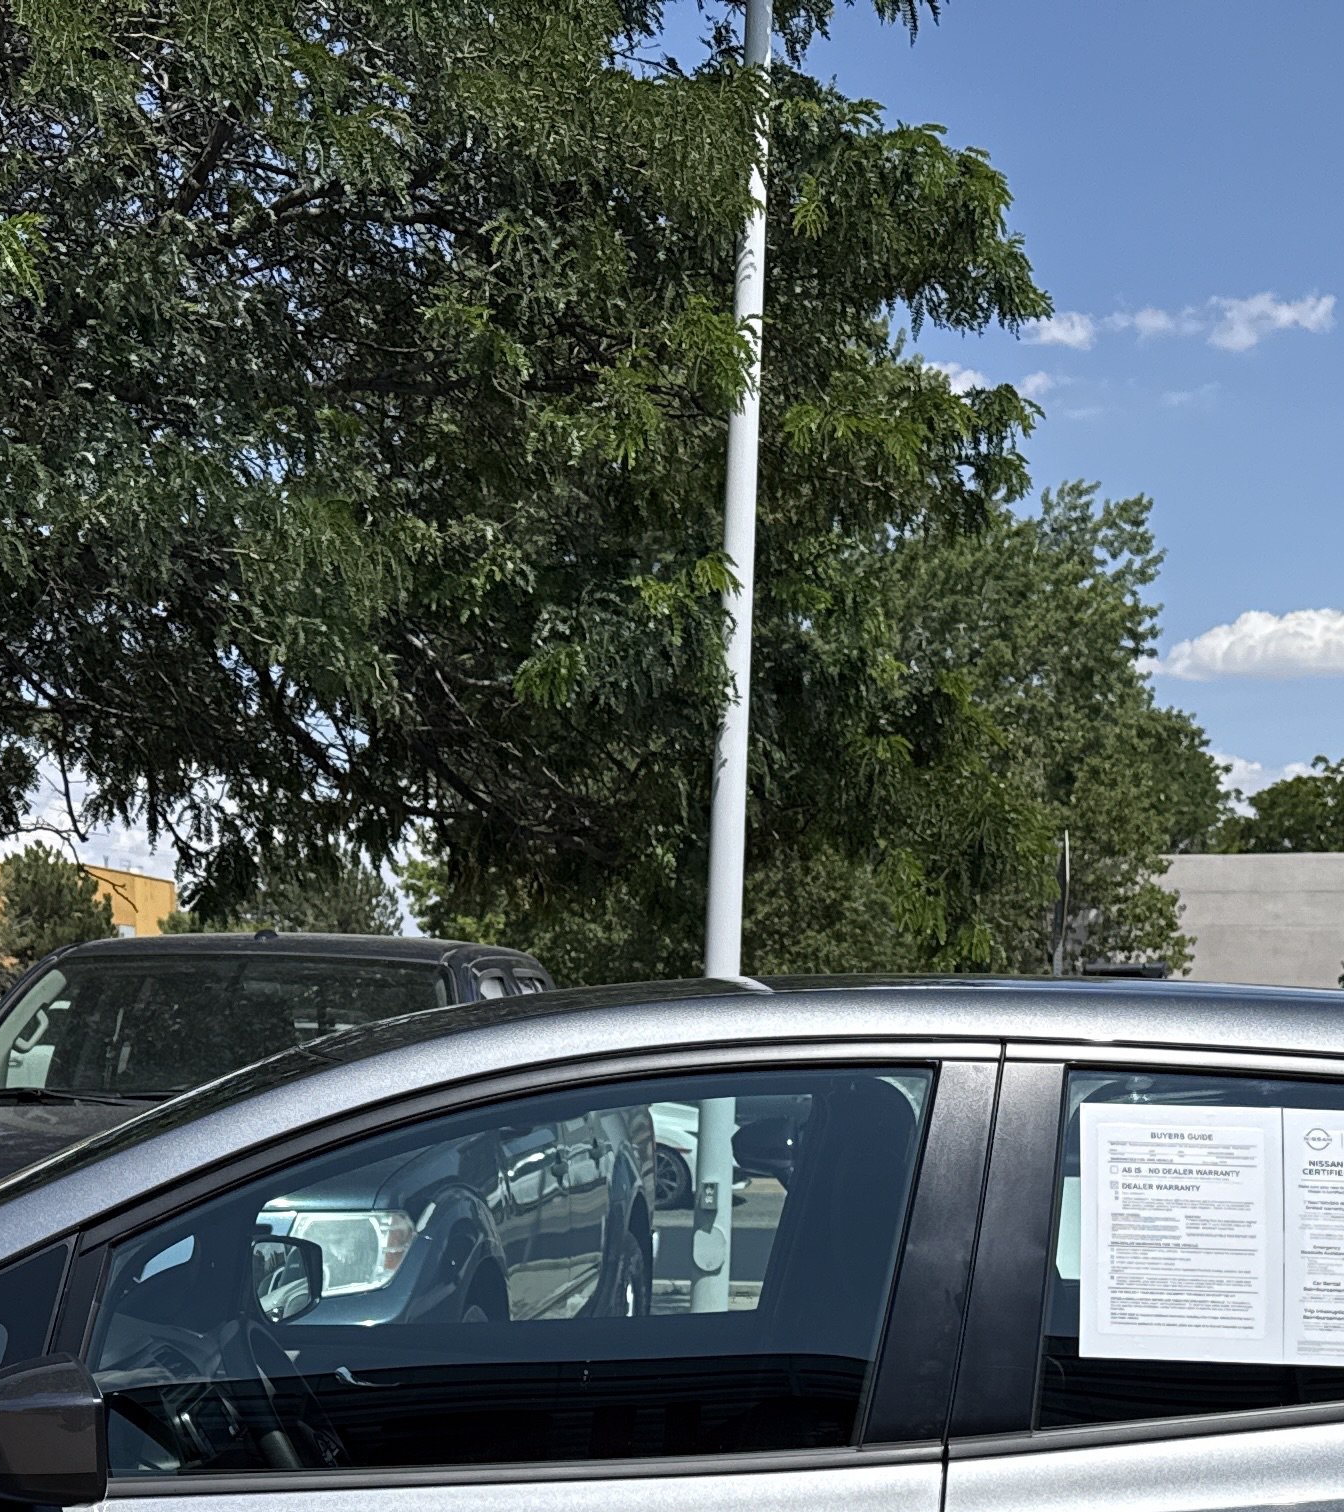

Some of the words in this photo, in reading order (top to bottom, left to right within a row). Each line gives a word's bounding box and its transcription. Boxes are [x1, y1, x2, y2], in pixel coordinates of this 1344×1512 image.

[1150, 1132, 1186, 1140] BUYERS
[1308, 1160, 1344, 1168] NISSAN
[1162, 1168, 1194, 1176] DEALER
[1121, 1183, 1154, 1191] DEALER
[1155, 1184, 1201, 1192] WARRANTY
